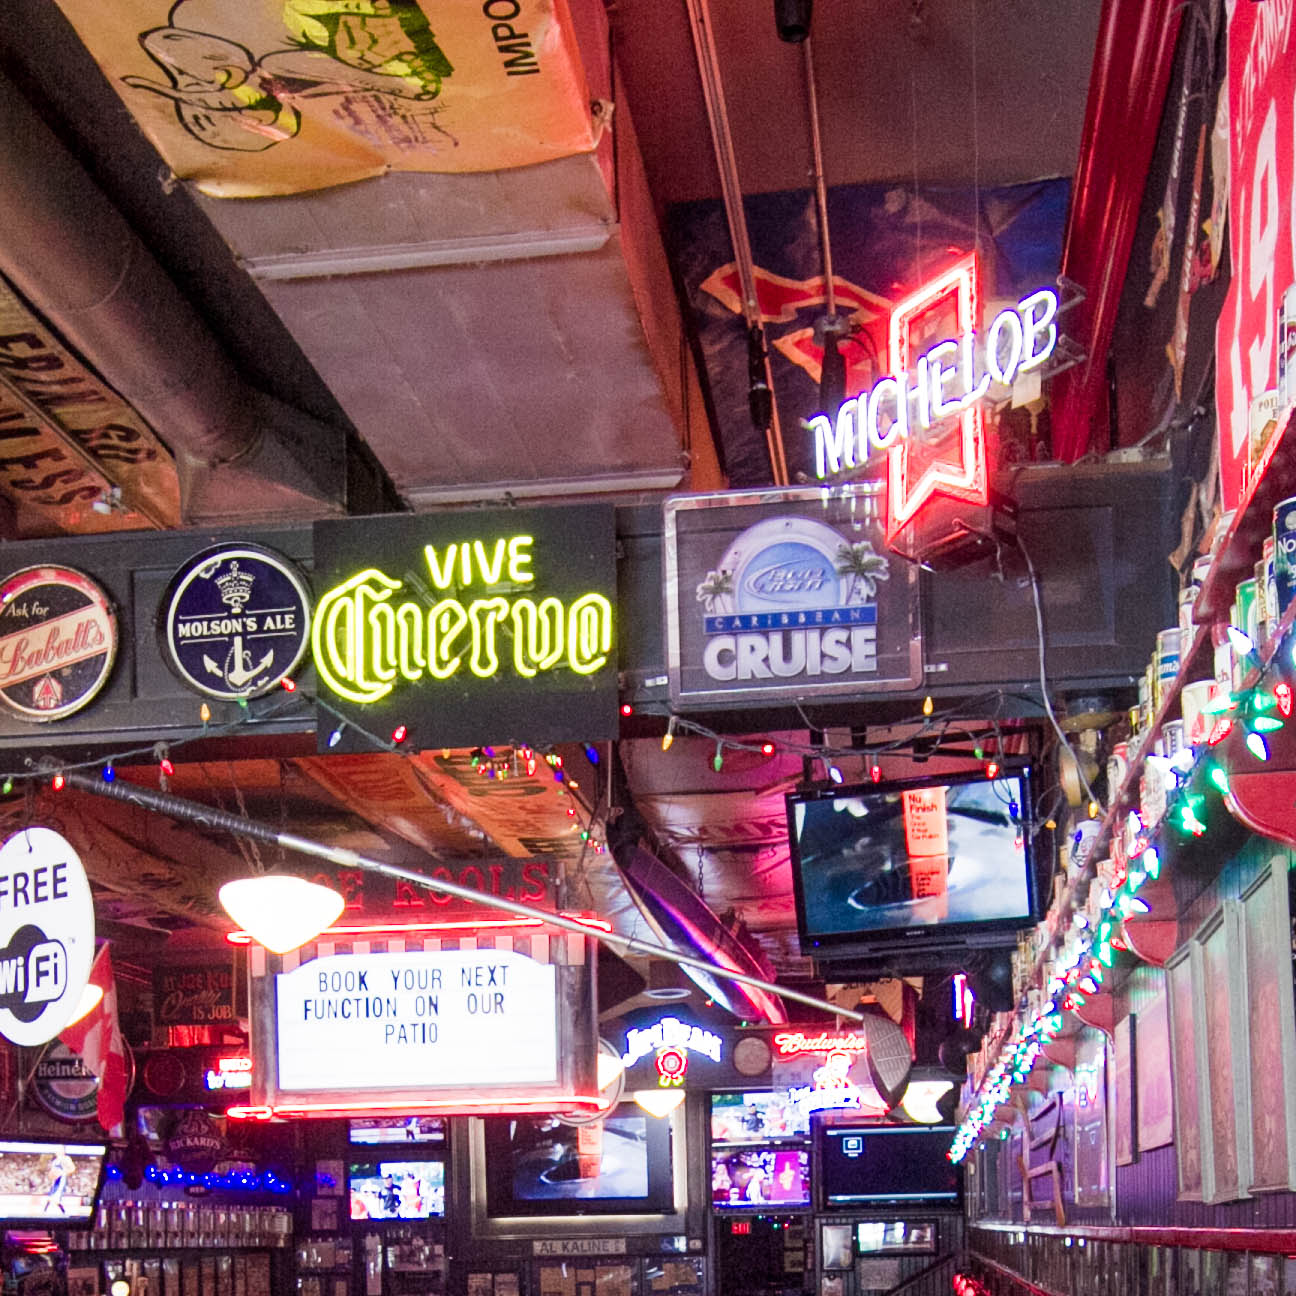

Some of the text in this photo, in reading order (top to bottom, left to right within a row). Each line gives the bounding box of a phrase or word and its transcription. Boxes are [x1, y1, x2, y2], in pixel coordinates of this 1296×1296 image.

[482, 0, 541, 77] IMPO
[808, 287, 1059, 479] MICHELOB
[423, 535, 535, 590] VIVE
[5, 601, 50, 618] Ask for
[714, 609, 862, 630] CARIBBEAN
[178, 614, 296, 639] MOLSON'S ALE
[311, 568, 613, 705] Cuervo
[703, 624, 878, 682] CRUISE
[318, 965, 510, 993] BOOK YOUR NEXT
[303, 993, 506, 1021] FUNCTION ON OUR
[384, 1022, 439, 1045] PATIO
